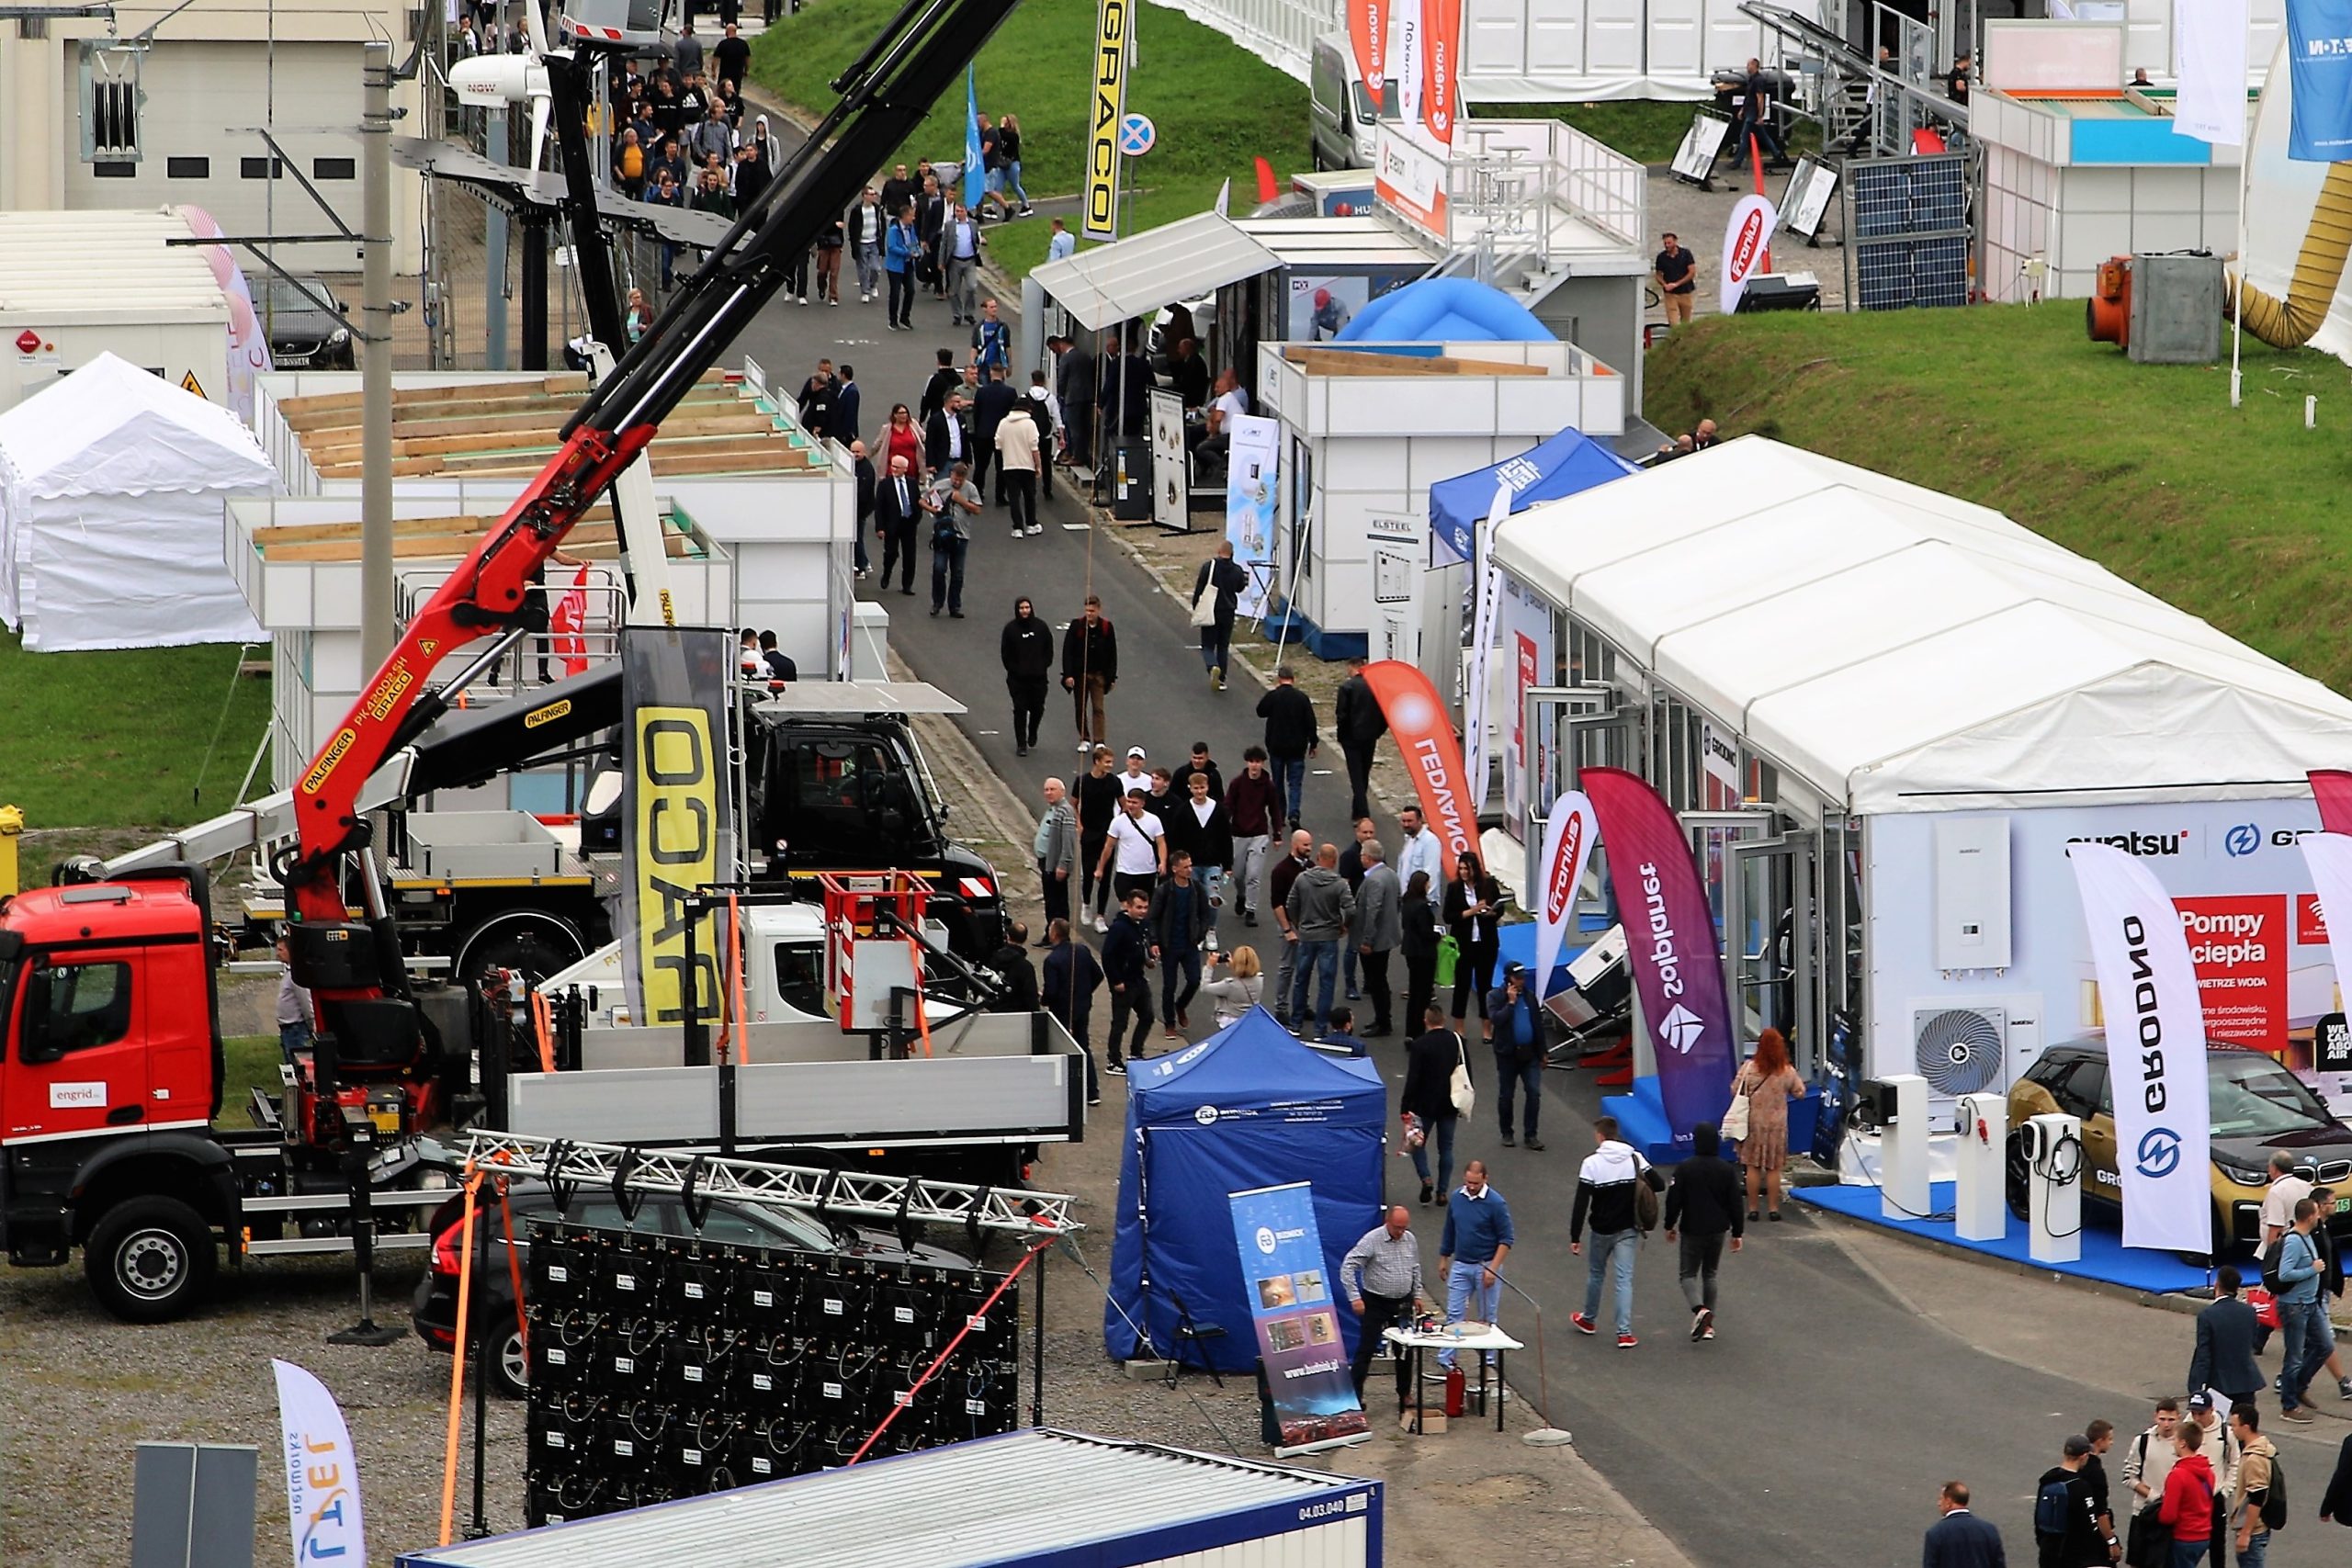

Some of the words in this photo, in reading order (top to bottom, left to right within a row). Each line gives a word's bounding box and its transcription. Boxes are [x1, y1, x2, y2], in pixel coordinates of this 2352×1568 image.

[1092, 1, 1123, 223] GRACO
[1373, 519, 1412, 533] ELSTEEL
[526, 702, 570, 726] PALFINGER
[306, 731, 354, 791] PALFINGER
[2180, 911, 2264, 937] Pompy
[2191, 940, 2266, 967] ciepła
[2237, 977, 2267, 987] WODA
[2217, 1028, 2267, 1037] niezawodne
[2327, 1024, 2346, 1034] WE
[2327, 1051, 2347, 1060] AIR
[57, 1088, 93, 1101] engrid
[1298, 1500, 1344, 1520] 04.03.040
